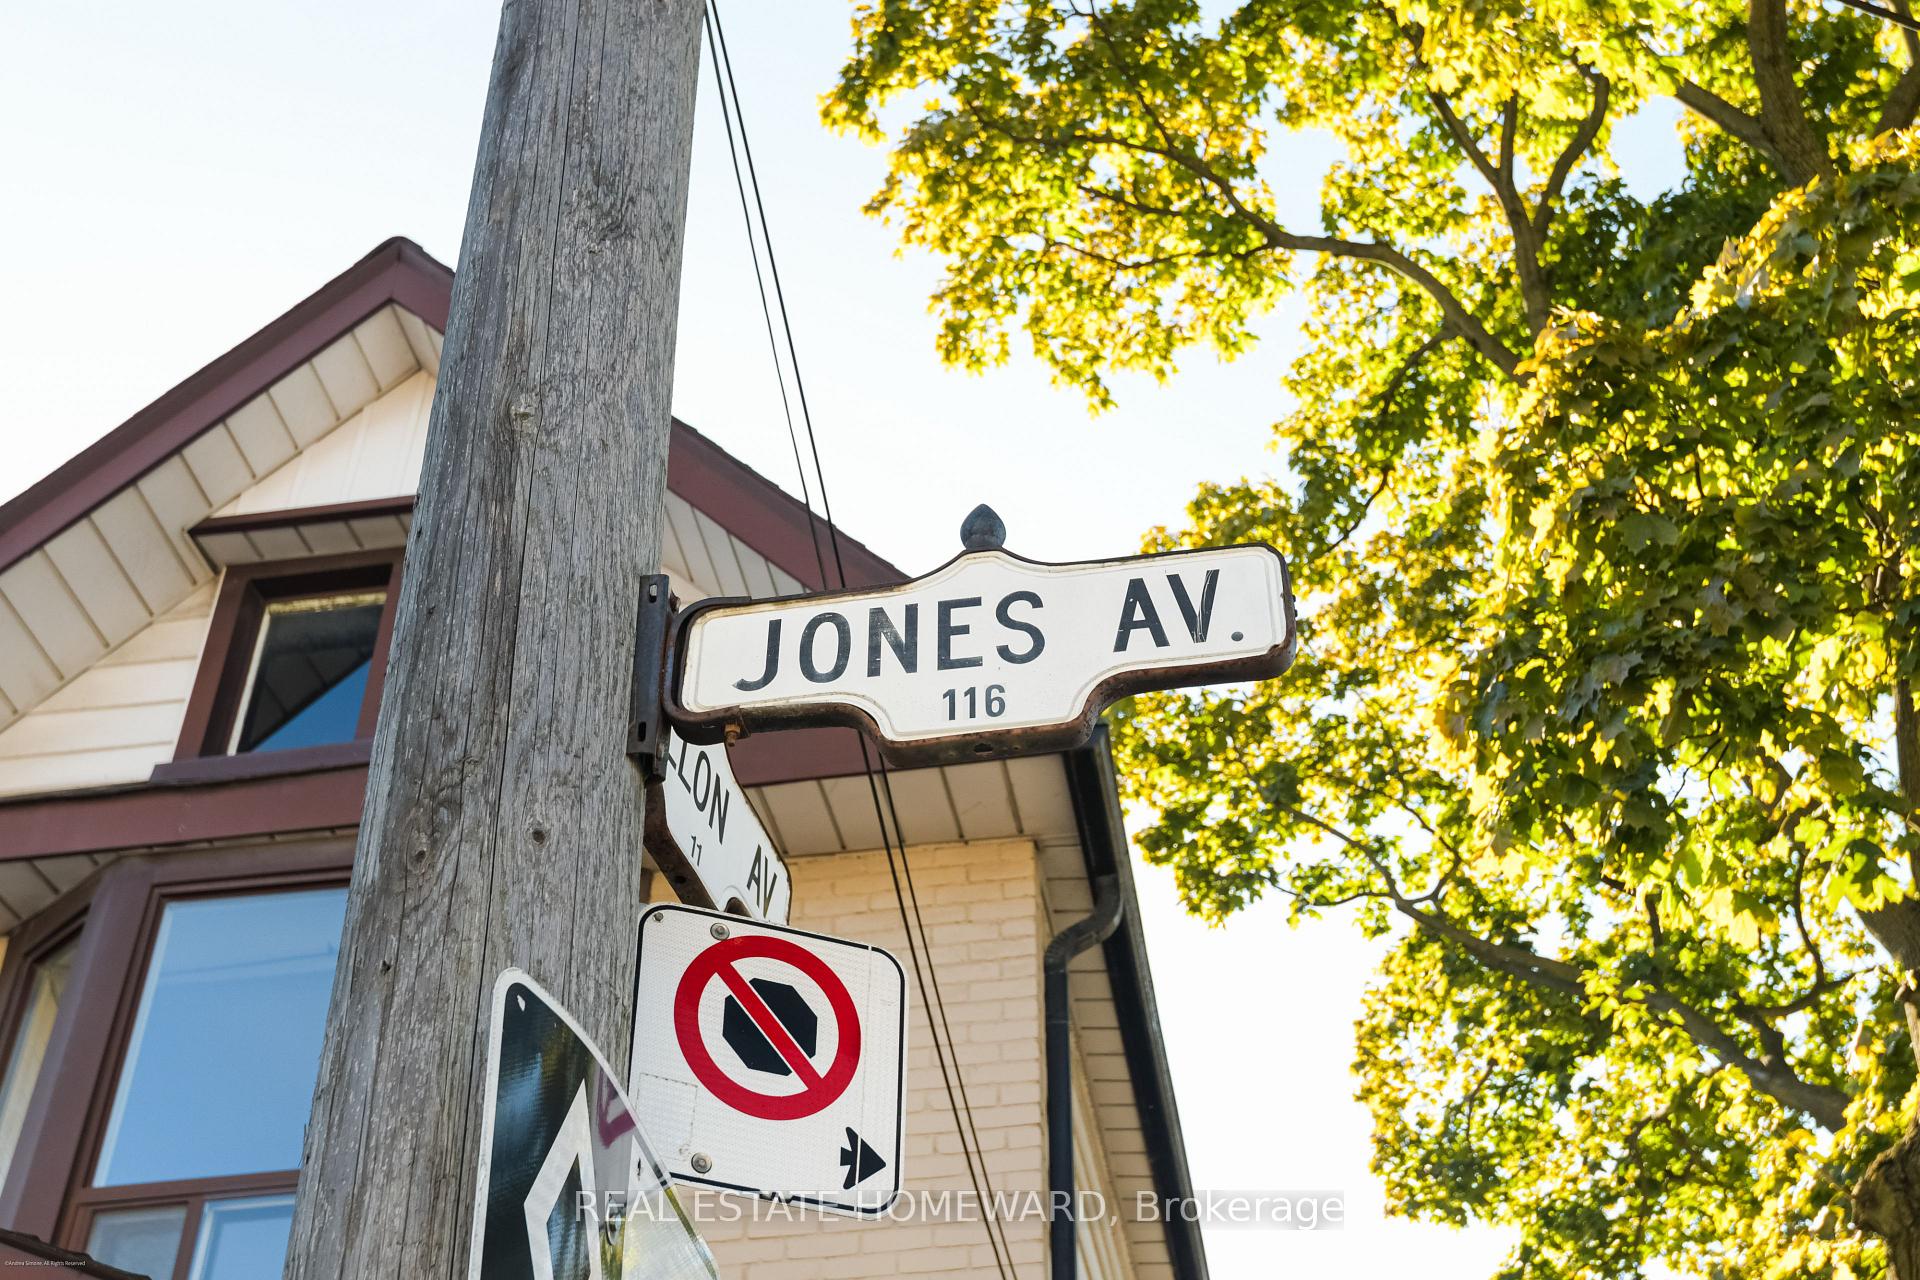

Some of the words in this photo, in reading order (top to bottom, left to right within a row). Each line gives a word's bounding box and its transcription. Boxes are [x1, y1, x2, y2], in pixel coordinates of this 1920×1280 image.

[731, 590, 1046, 692] JONES
[1113, 569, 1244, 652] AV.
[942, 684, 1006, 721] 116
